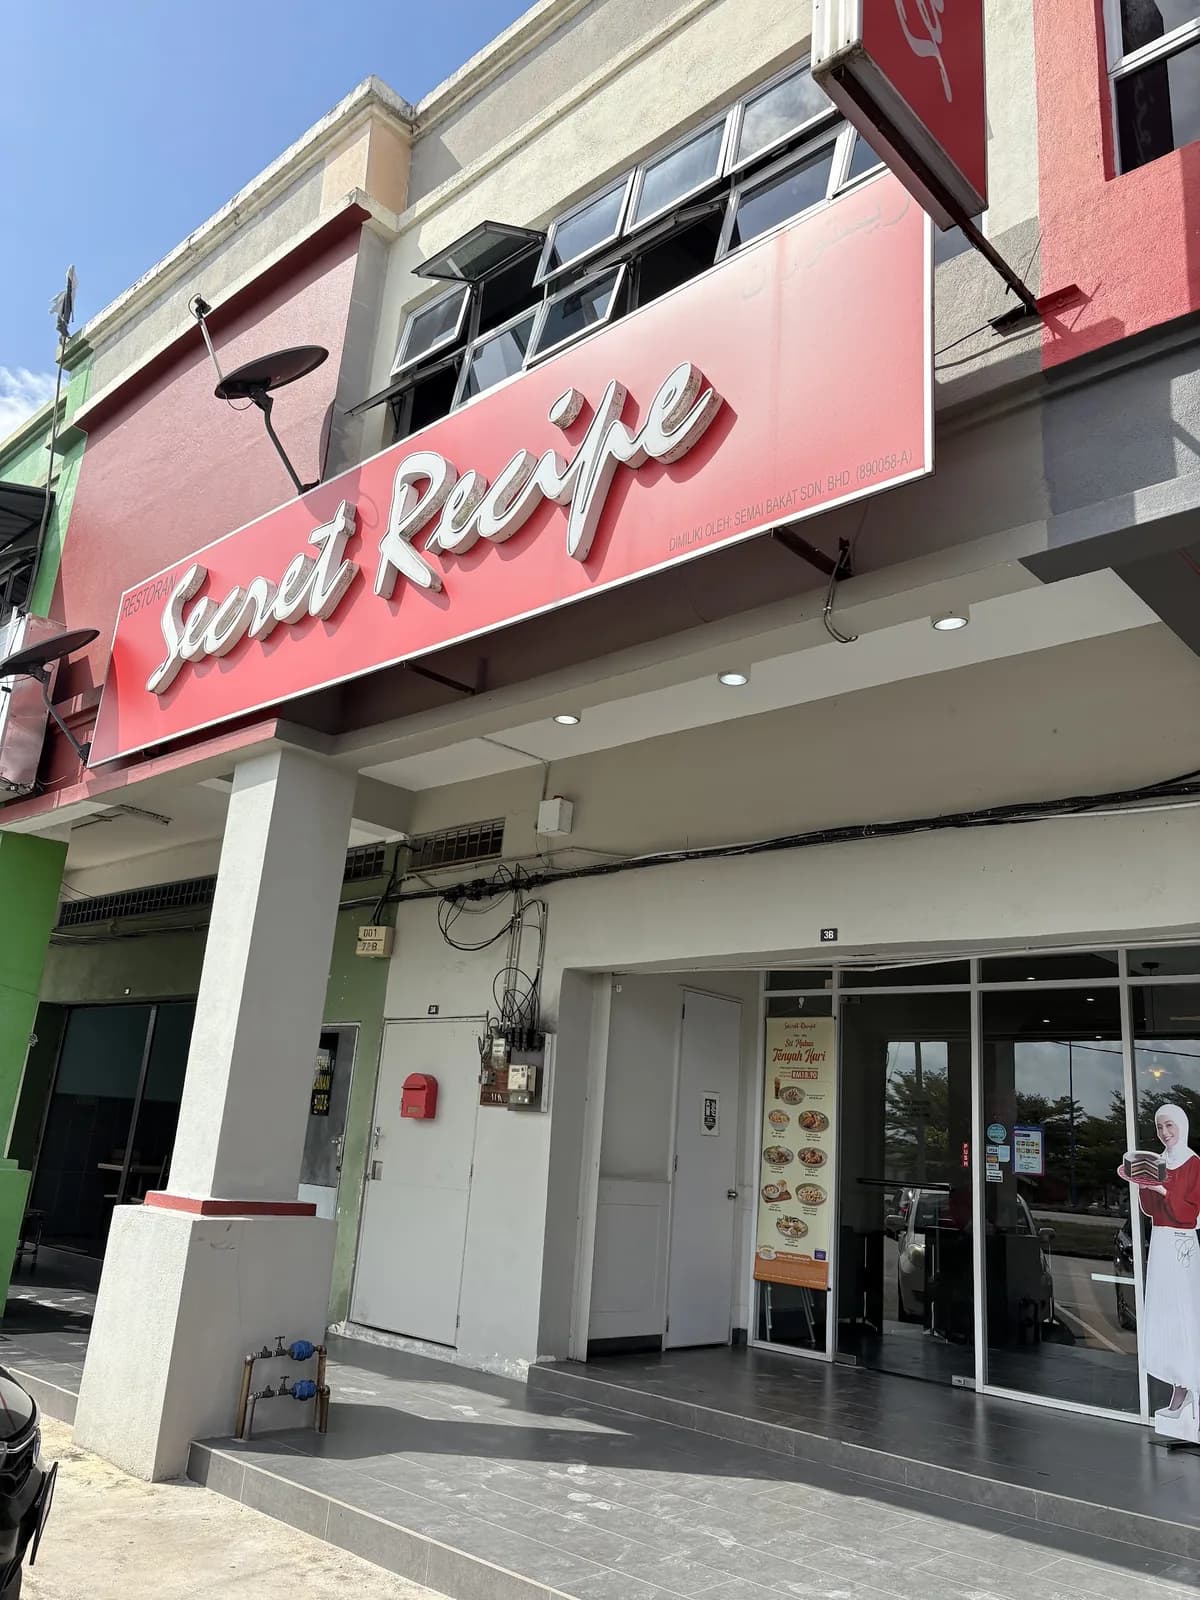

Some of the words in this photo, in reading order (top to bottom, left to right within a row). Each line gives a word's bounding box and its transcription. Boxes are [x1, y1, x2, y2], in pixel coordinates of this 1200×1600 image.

[146, 499, 360, 695] Secret
[374, 361, 723, 600] Recipe
[669, 526, 703, 552] DIMILIKI
[705, 514, 732, 537] OLEH:
[734, 502, 764, 527] SEMAI
[766, 488, 798, 514] BAKAT
[800, 479, 825, 501] SDN.
[856, 448, 912, 480] (890058-A)
[121, 573, 177, 620] RESTORAN
[773, 1048, 802, 1064] Tengah
[804, 1048, 826, 1064] Hari
